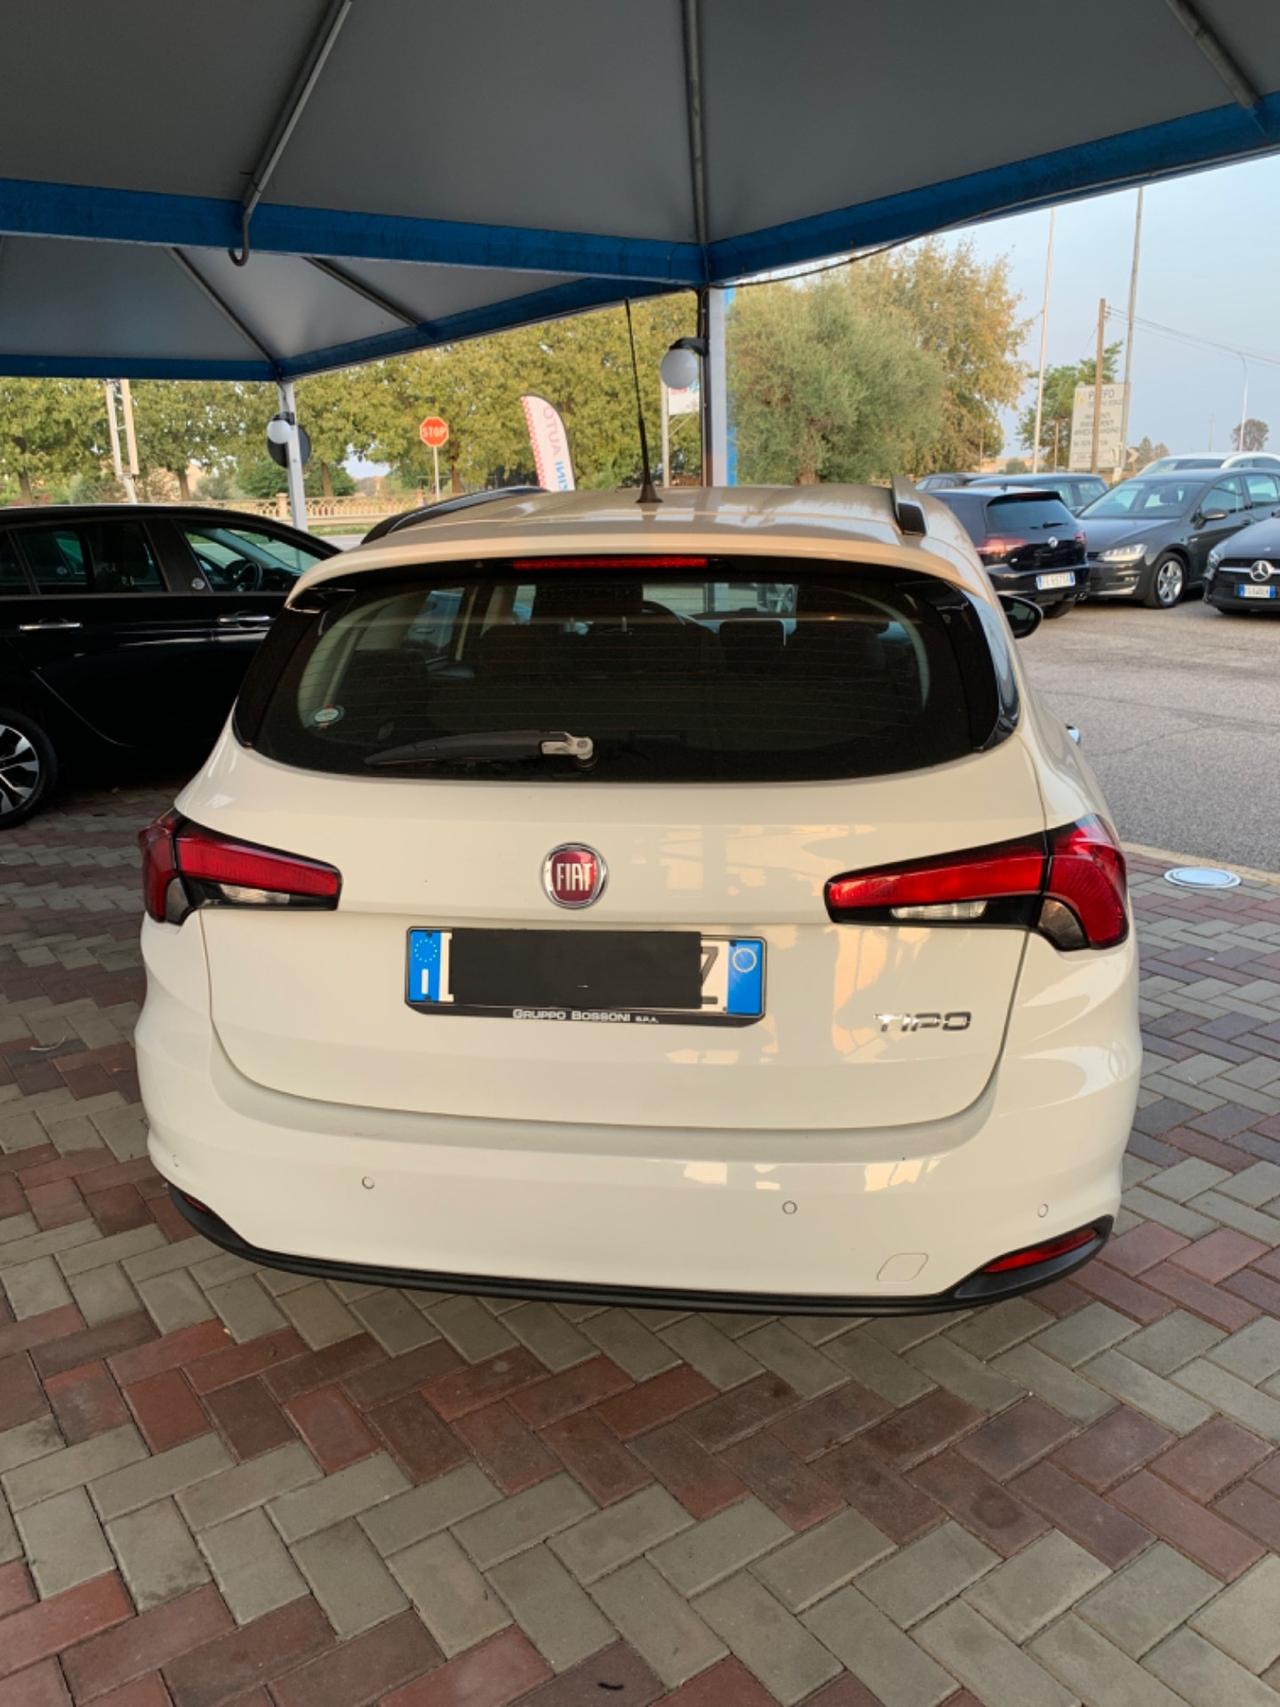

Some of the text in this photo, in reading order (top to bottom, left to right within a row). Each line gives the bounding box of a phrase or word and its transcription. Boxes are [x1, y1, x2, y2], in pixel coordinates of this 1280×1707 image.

[422, 426, 448, 438] STOP
[556, 862, 594, 891] FIAT
[512, 1008, 566, 1020] GRUPPO
[571, 1010, 631, 1022] BOSSONI
[873, 1011, 972, 1032] TIPO
